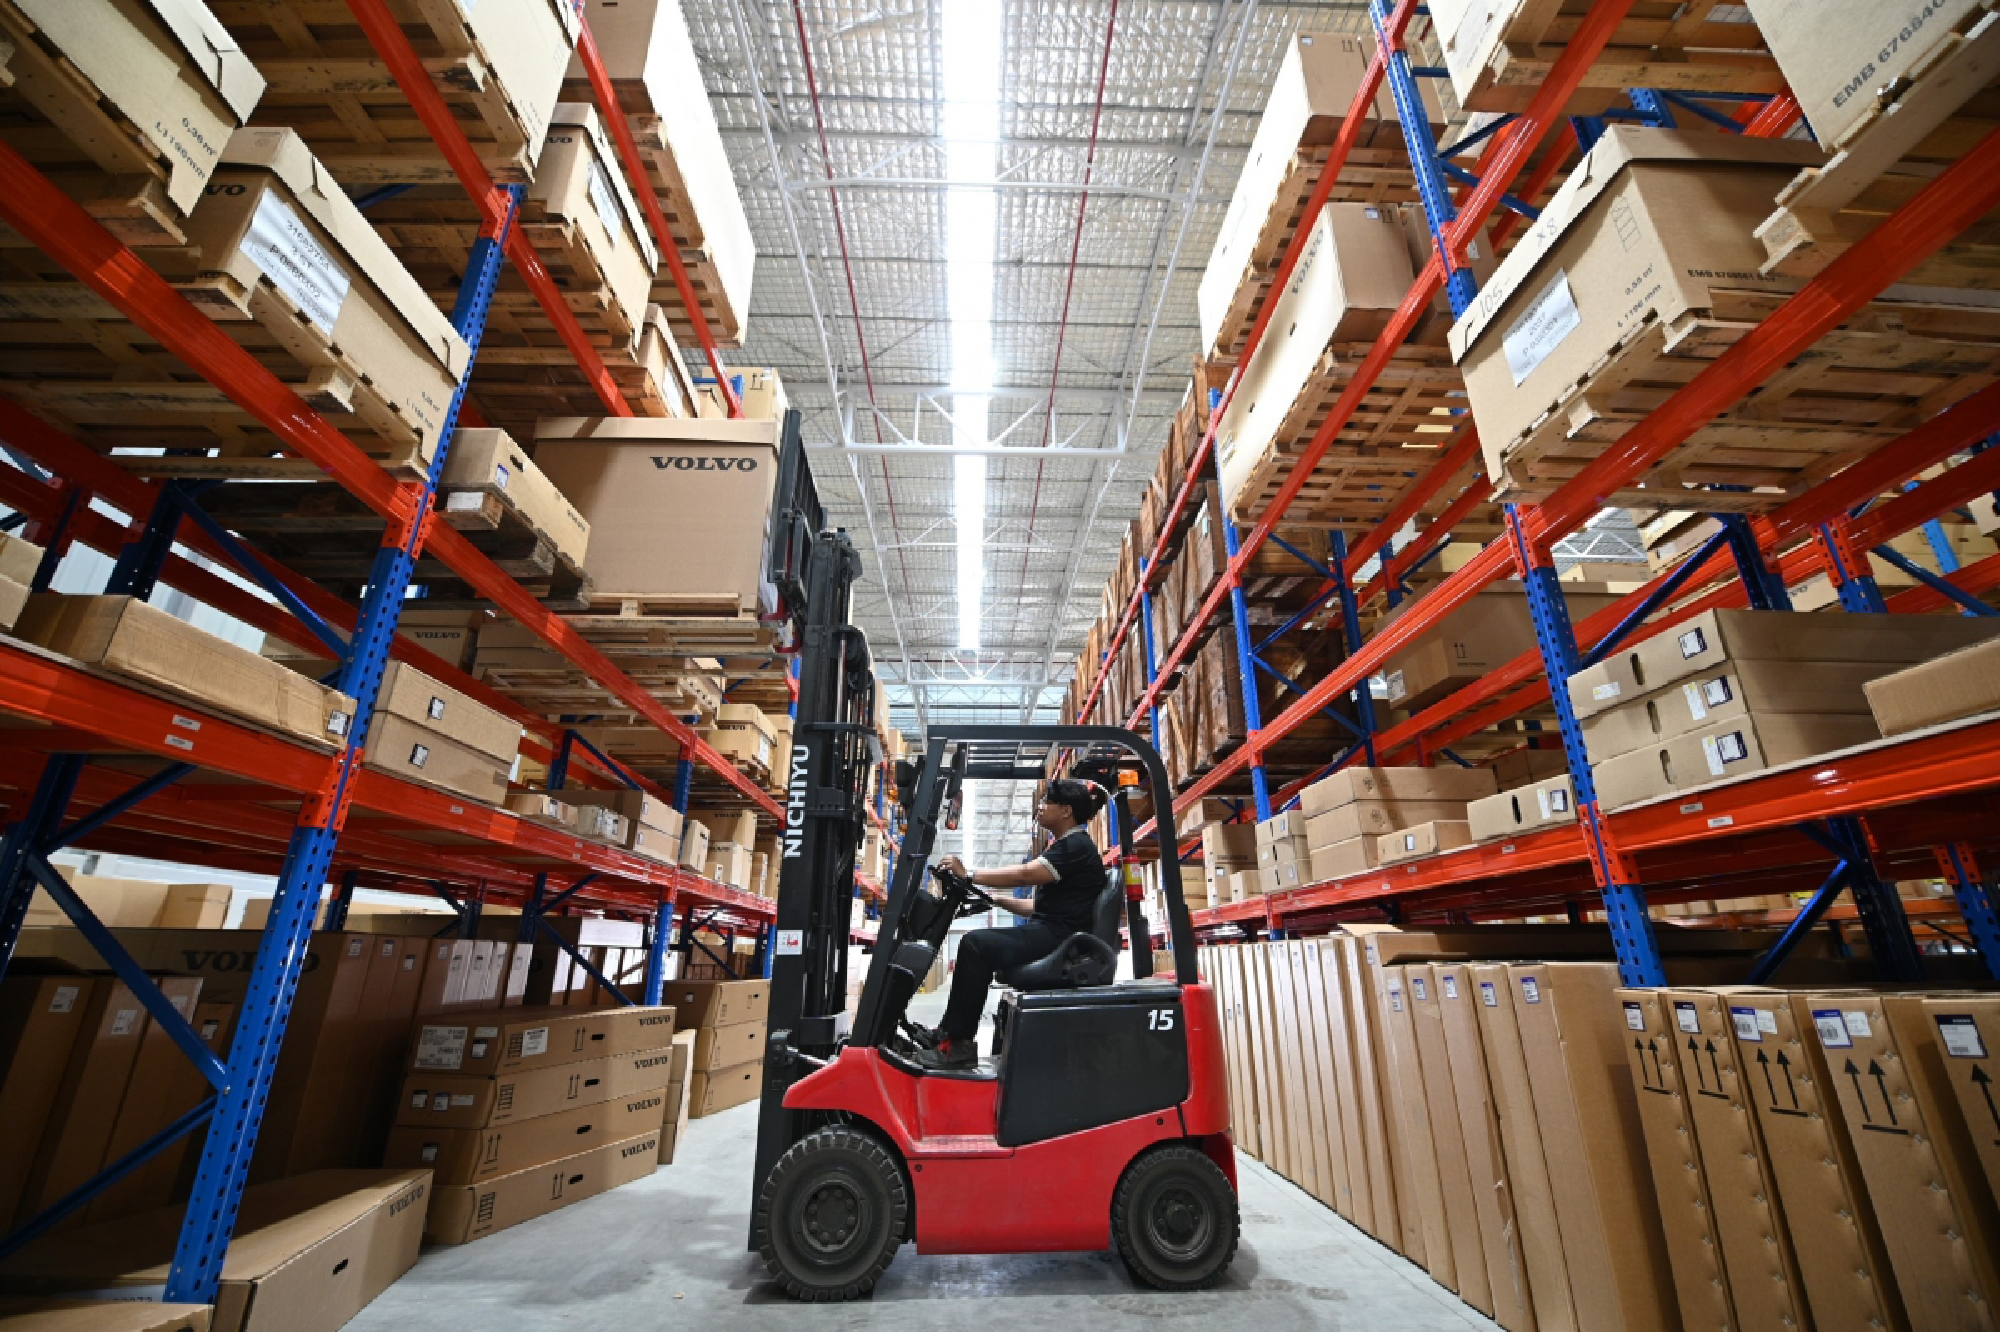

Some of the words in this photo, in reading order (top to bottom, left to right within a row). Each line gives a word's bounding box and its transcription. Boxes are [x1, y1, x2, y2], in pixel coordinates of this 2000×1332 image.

[1832, 62, 1876, 108] EMB
[1291, 229, 1324, 294] VOLVO
[649, 456, 758, 472] VOLVO
[415, 631, 461, 639] VOLVO
[783, 743, 811, 859] NICHIYU
[182, 949, 321, 973] VOLO
[638, 1014, 671, 1027] VOLVO
[1147, 1009, 1174, 1031] 15
[633, 1054, 669, 1070] VOLVO
[626, 1096, 662, 1113] VOLVO
[620, 1139, 657, 1159] VOLVO
[389, 1184, 424, 1218] VOLVO
